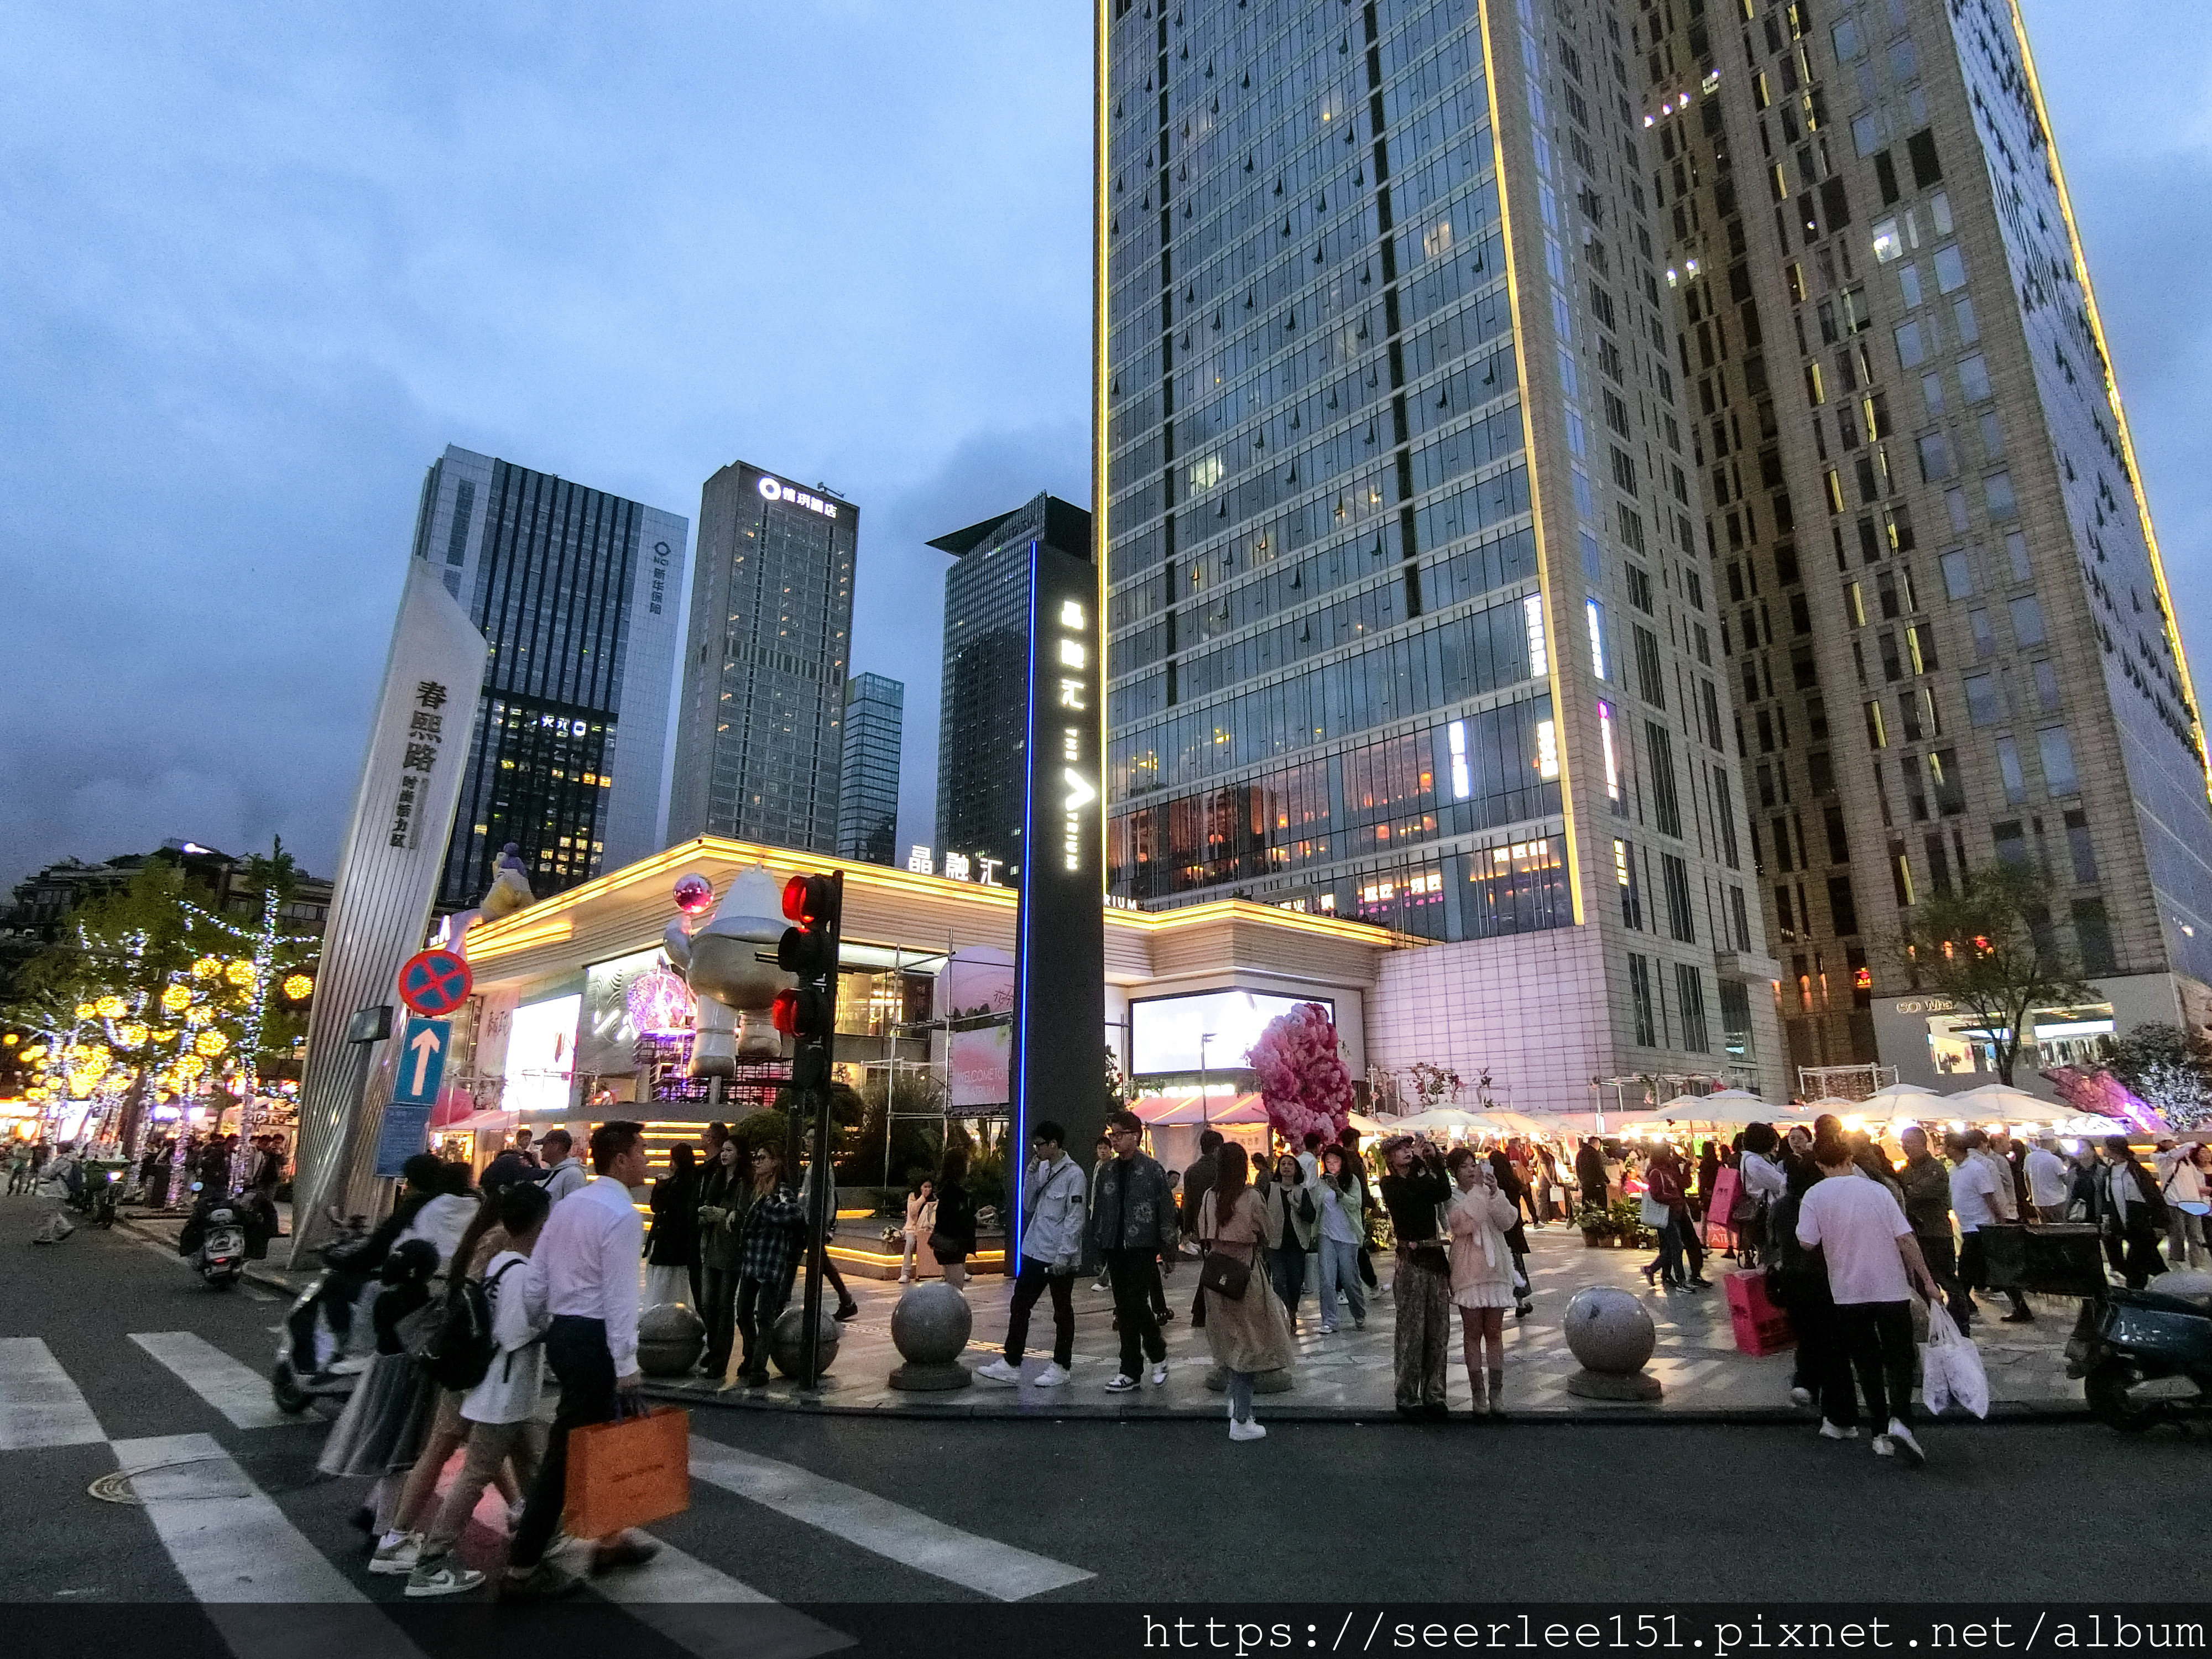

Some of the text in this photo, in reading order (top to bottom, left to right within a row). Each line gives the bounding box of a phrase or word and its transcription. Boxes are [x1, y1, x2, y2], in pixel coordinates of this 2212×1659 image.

[403, 681, 447, 773] 春熙路
[908, 844, 1004, 888] 晶融汇
[1103, 894, 1138, 911] RIUM
[957, 1068, 994, 1083] WELCOME
